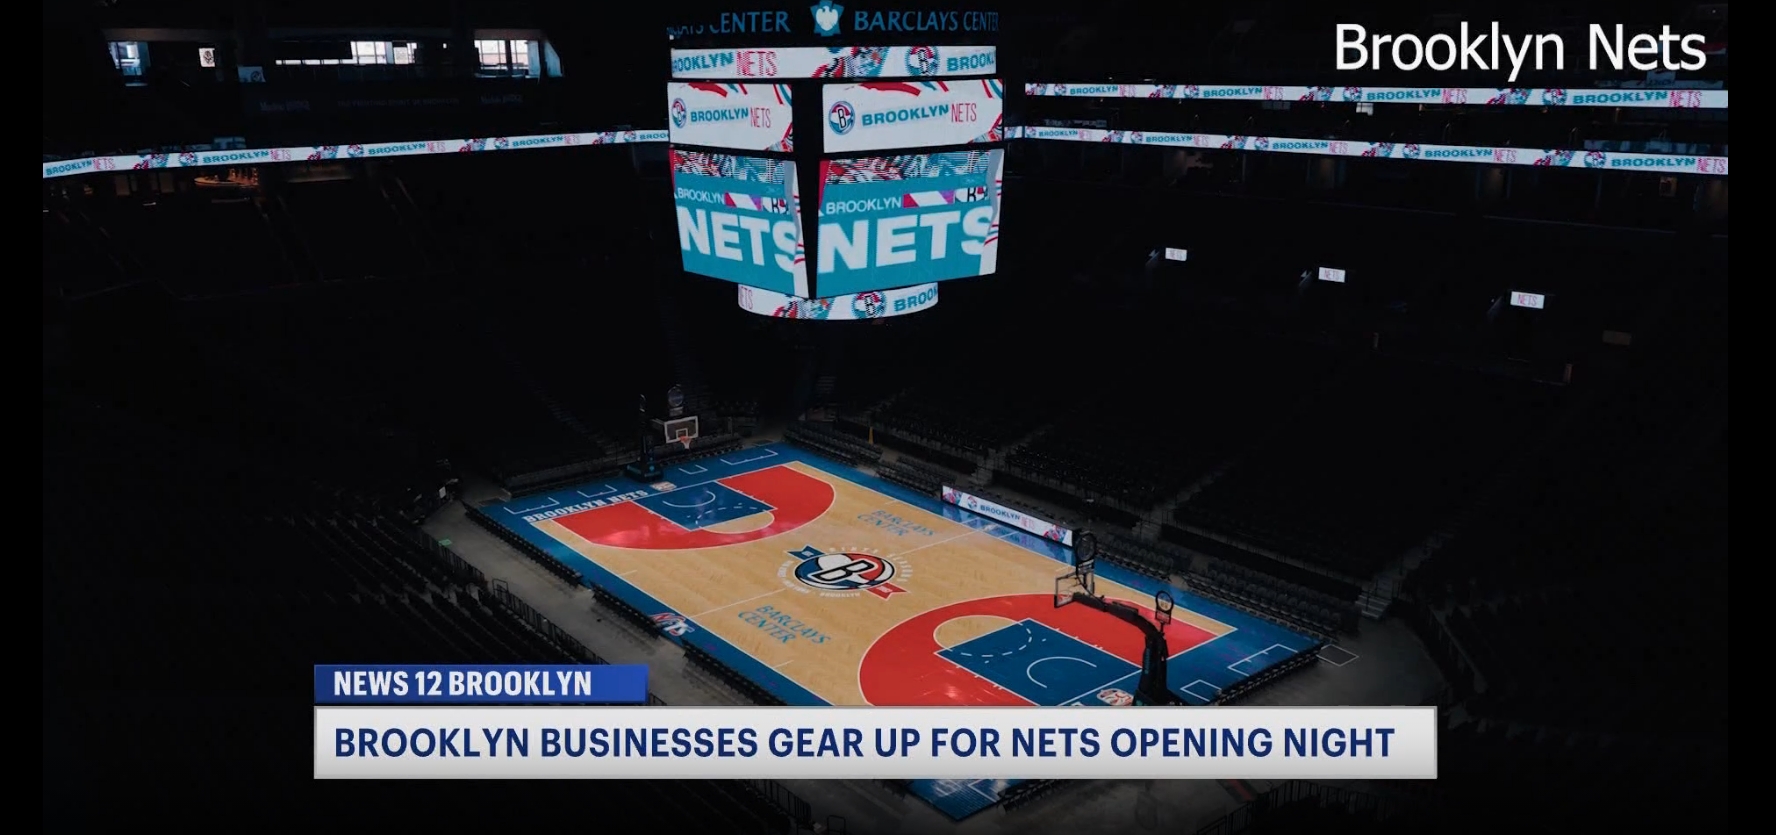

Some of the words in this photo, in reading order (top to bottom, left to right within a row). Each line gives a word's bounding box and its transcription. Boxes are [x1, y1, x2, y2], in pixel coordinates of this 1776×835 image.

[854, 11, 958, 32] BARCLAYS
[736, 50, 778, 76] NETS
[1070, 85, 1118, 96] BROOKLYN
[1203, 87, 1262, 98] BROOKLYN
[1367, 88, 1441, 102] BROOKLYN
[1441, 88, 1467, 104] NETS
[1573, 91, 1667, 105] BROOKLYN
[1669, 90, 1702, 107] NETS
[690, 107, 749, 122] BROOKLYN
[750, 107, 771, 129] NETS
[862, 104, 949, 126] BROOKLYN
[951, 103, 977, 123] NETS
[512, 135, 563, 147] BROOKLYN
[1038, 130, 1078, 138] BROOKLYN
[1145, 135, 1192, 144] BROOKLYN
[368, 142, 426, 155] BROOKLYN
[1272, 142, 1328, 151] BROOKLYN
[1425, 149, 1492, 159] BROOKLYN
[202, 150, 269, 164] BROOKLYN
[1611, 157, 1695, 168] BROOKLYN
[1697, 157, 1726, 174] NETS
[45, 160, 92, 176] BROOKLYN
[678, 187, 725, 205] BROOKLYN
[826, 197, 901, 215] BROOKLYN
[676, 205, 799, 269] NETS
[819, 206, 994, 274] NETS
[521, 499, 606, 522] BROOKLYN
[608, 489, 649, 504] NETS
[981, 505, 1020, 520] BROOKLYN
[871, 510, 934, 536] BARCLAYS
[738, 612, 796, 643] CENTER
[756, 605, 831, 644] BARCLAYS
